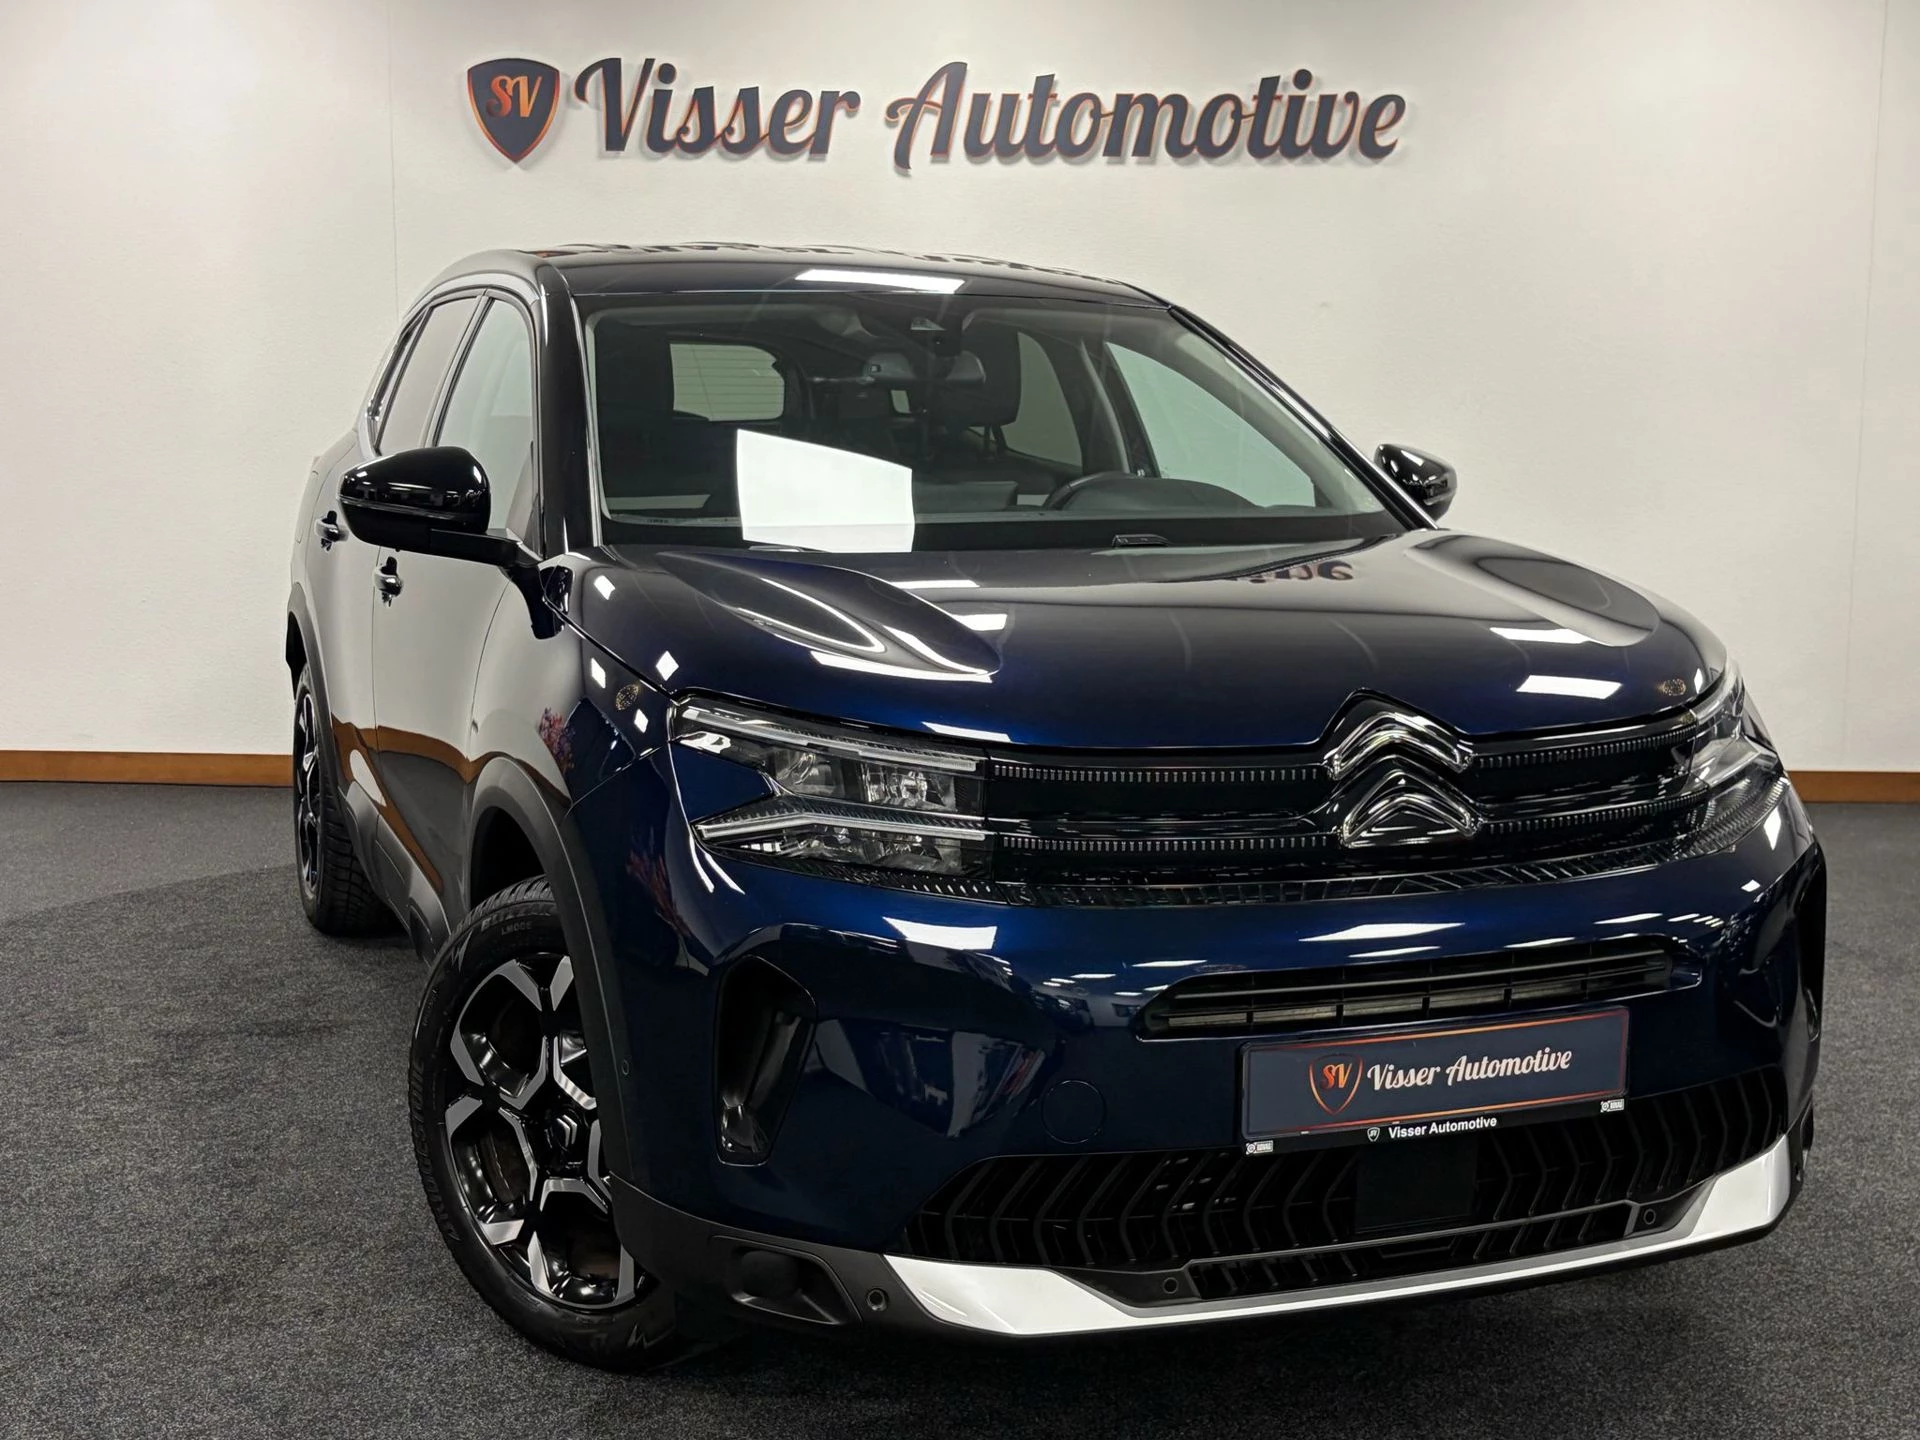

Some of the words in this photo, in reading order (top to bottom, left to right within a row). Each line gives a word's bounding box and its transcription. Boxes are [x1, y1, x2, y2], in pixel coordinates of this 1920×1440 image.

[485, 75, 543, 118] SV
[574, 57, 861, 156] Visser
[885, 61, 1406, 170] Automotive
[1322, 1063, 1353, 1090] SV
[1367, 1063, 1441, 1091] Visser
[1445, 1047, 1573, 1087] Automotive
[1388, 1124, 1427, 1139] Visser
[1429, 1116, 1498, 1135] Automotive
